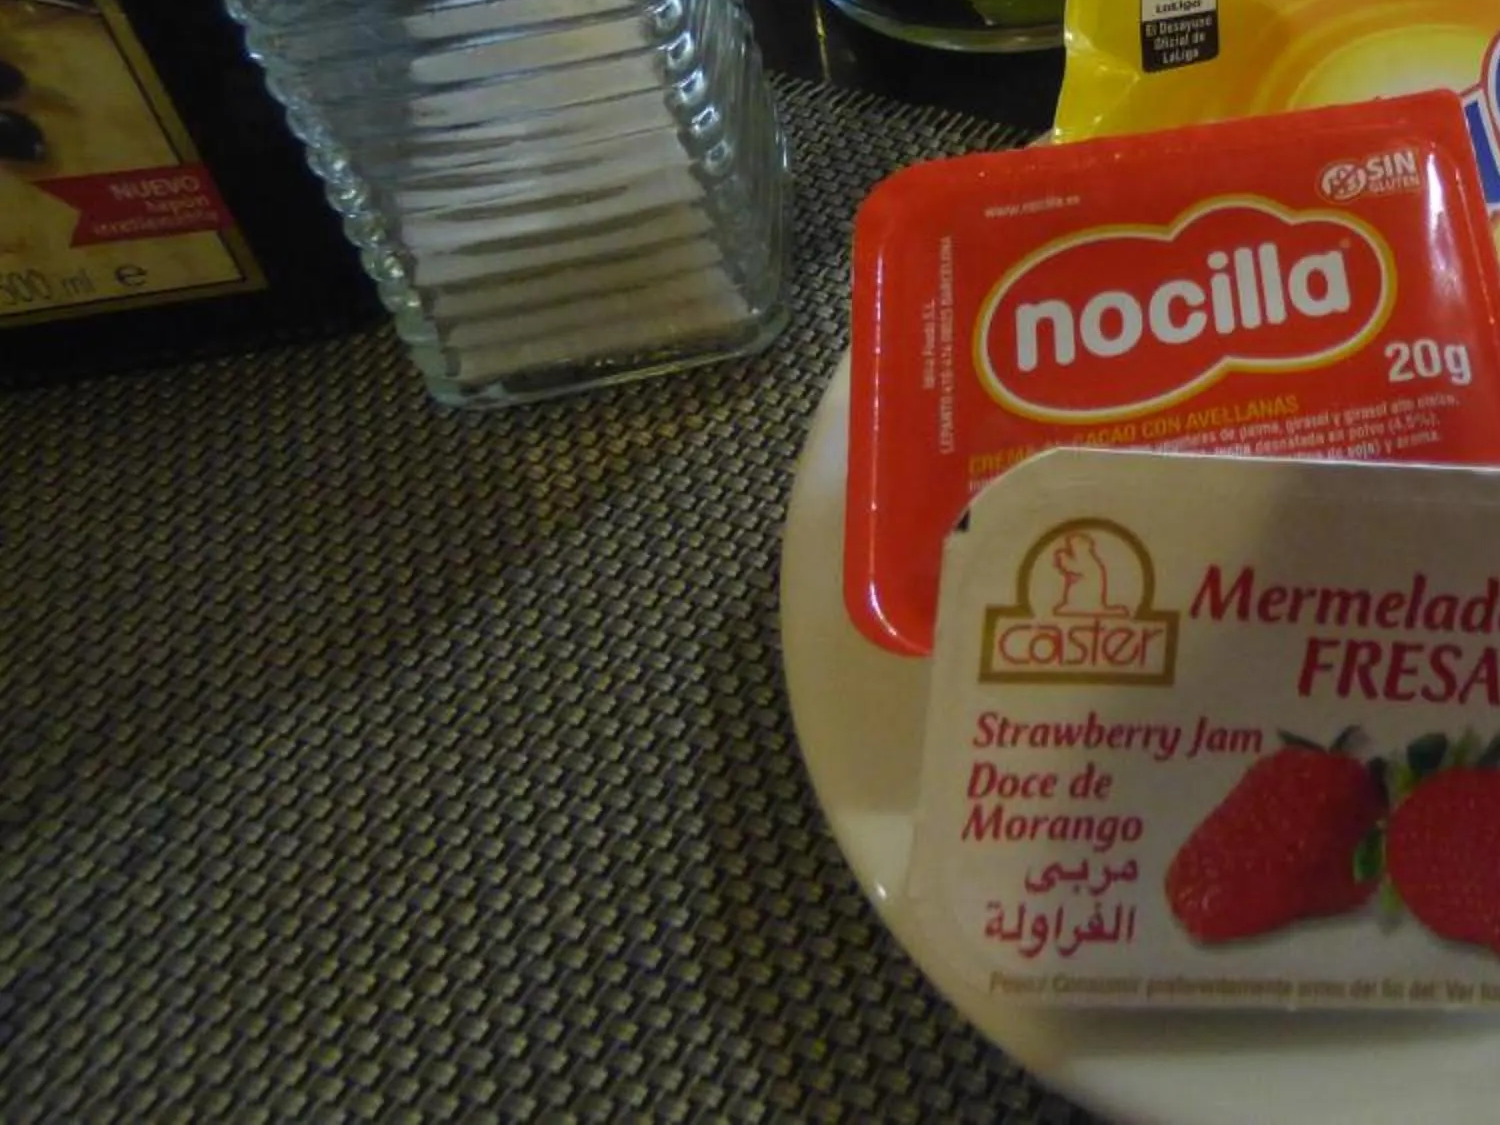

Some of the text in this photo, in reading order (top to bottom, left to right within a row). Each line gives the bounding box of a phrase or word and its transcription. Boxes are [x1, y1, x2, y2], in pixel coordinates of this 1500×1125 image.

[107, 174, 200, 201] NUEVO
[1365, 149, 1417, 182] SIN
[1367, 175, 1421, 194] GLUTEN
[939, 235, 954, 307] BARCELONA
[1014, 240, 1352, 373] nocilla
[1383, 337, 1475, 388] 20g
[1141, 412, 1182, 438] CON
[1186, 394, 1300, 428] AVELLANAS
[998, 622, 1168, 669] caster
[973, 711, 1265, 761] Strawberry Jam
[967, 761, 1113, 803] Doce de
[961, 805, 1145, 852] Morango
